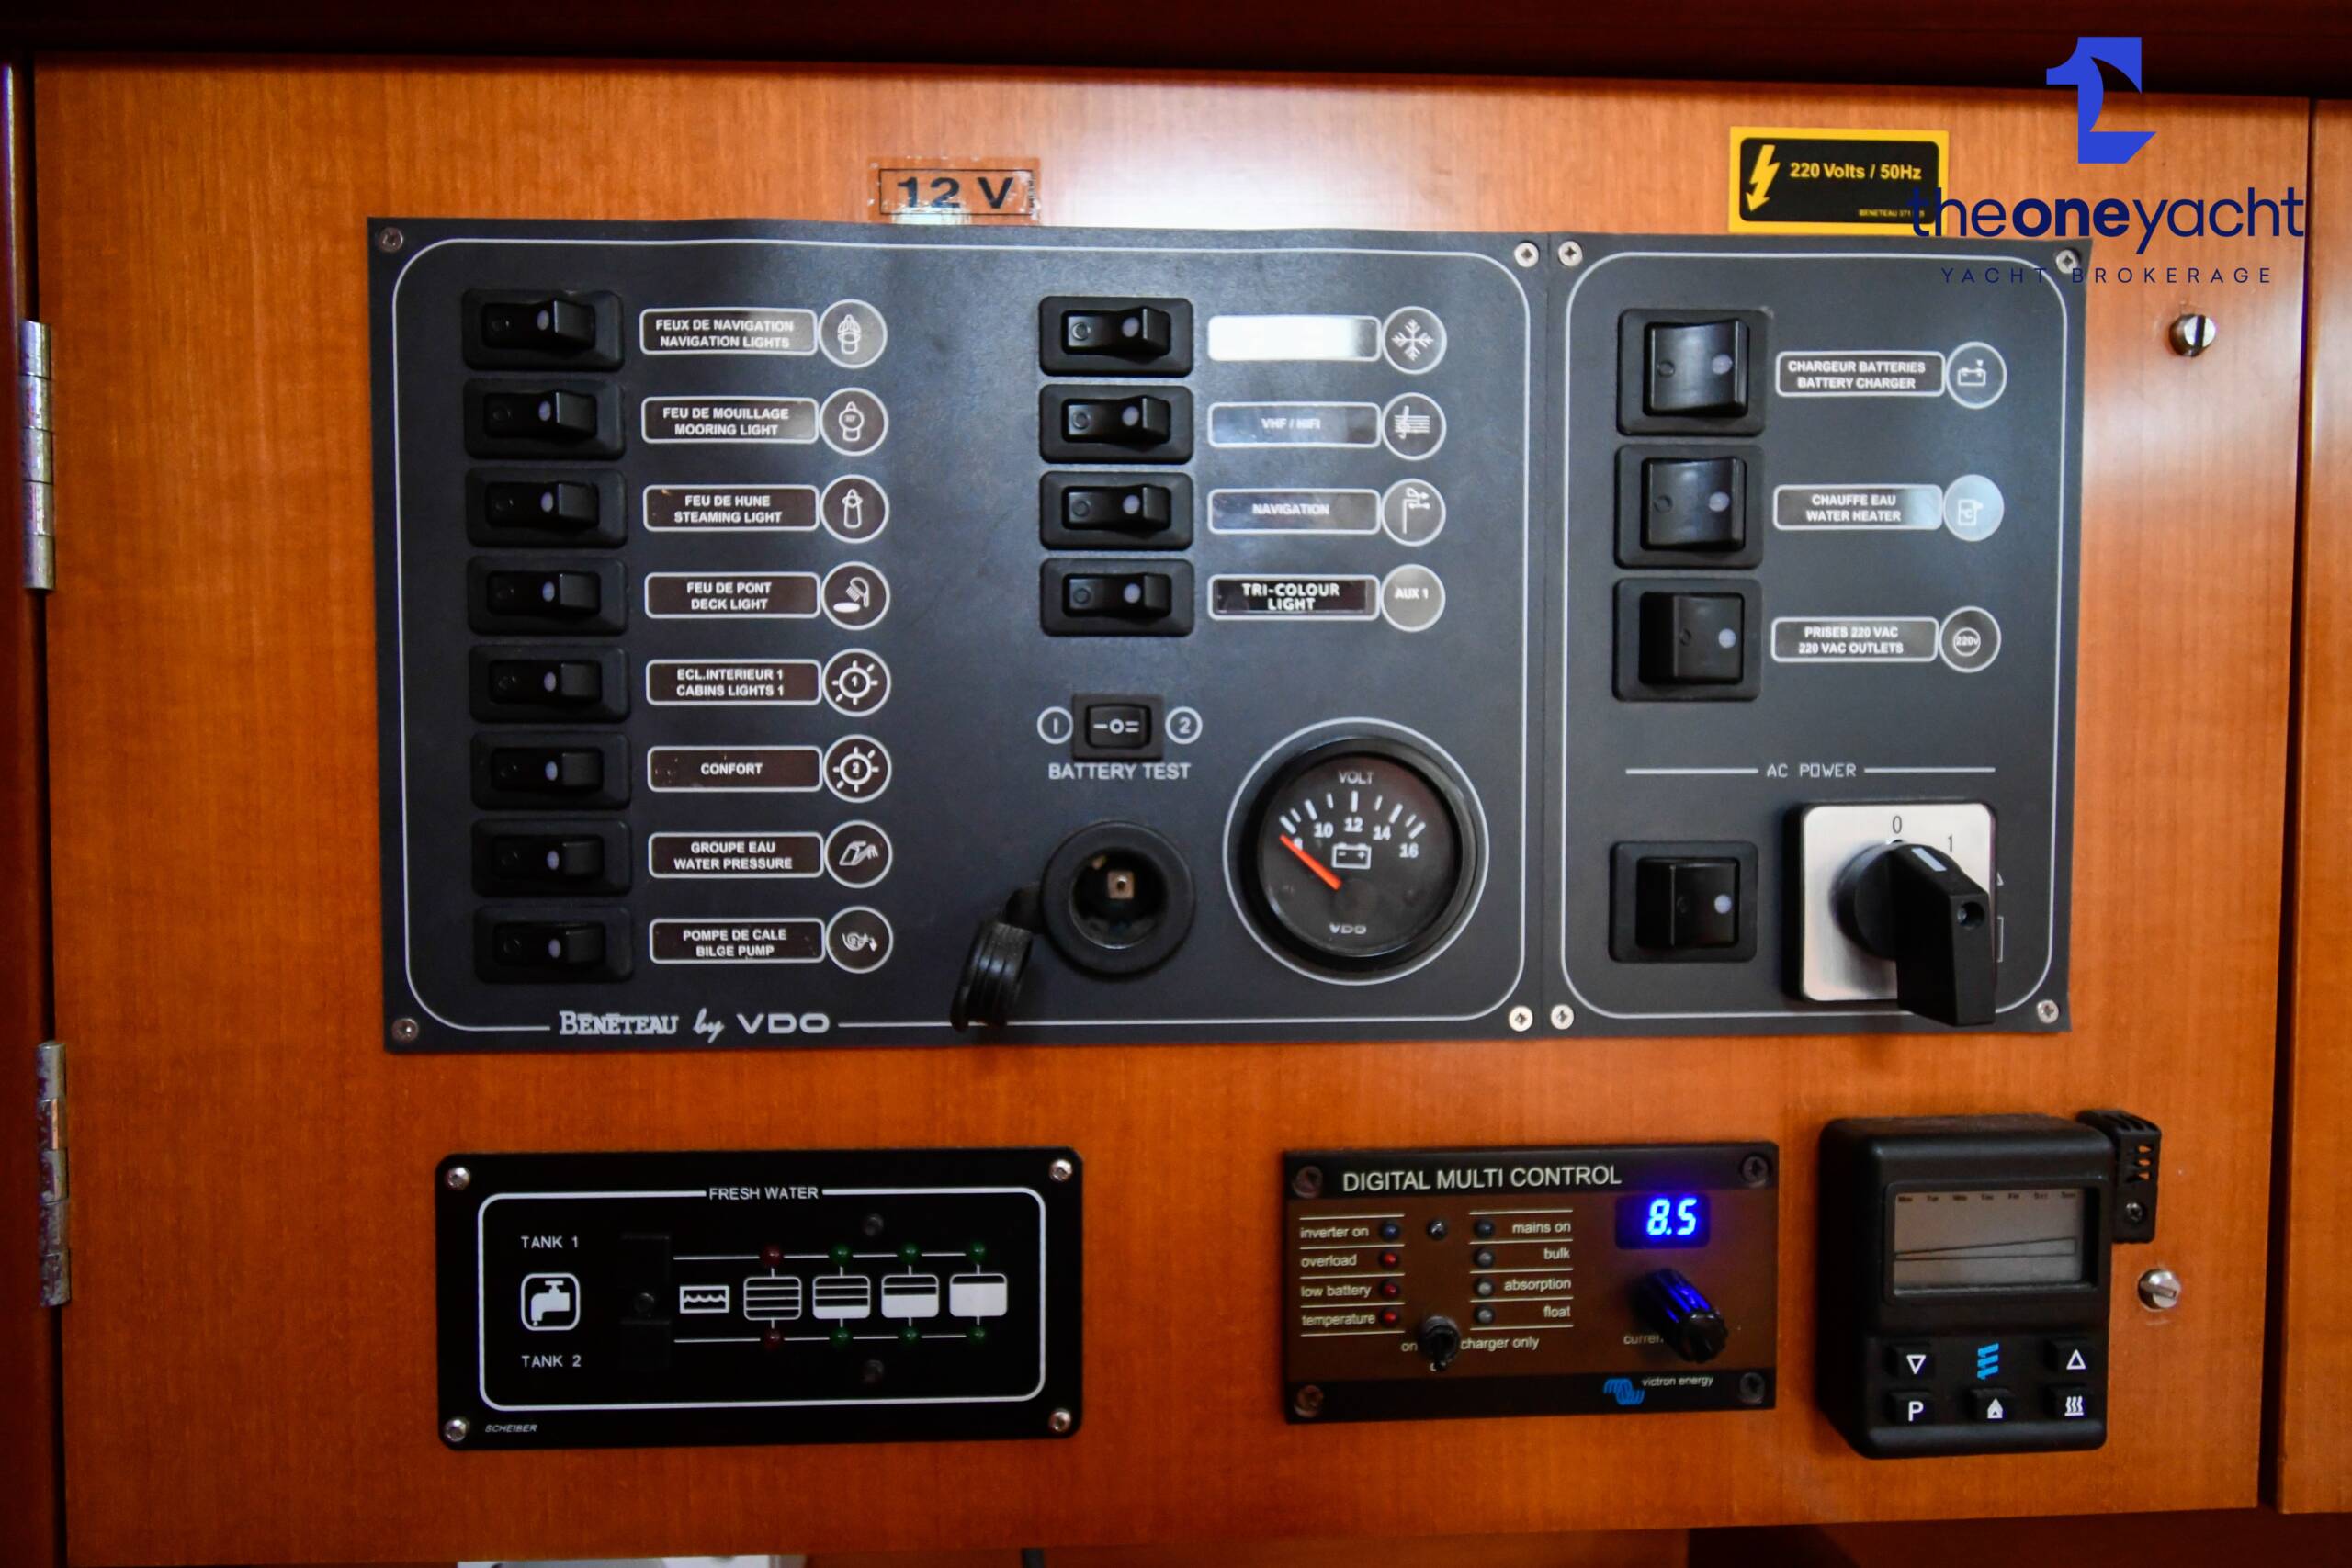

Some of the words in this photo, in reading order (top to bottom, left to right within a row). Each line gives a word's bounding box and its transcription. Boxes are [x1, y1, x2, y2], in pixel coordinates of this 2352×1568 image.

[1790, 162, 1821, 178] 220
[1824, 162, 1866, 179] Volts
[1869, 163, 1876, 180] /
[1880, 163, 1922, 181] 50Hz
[897, 176, 961, 209] 12
[977, 176, 1014, 209] V
[655, 319, 690, 332] FEUX
[694, 319, 710, 332] DE
[713, 319, 795, 333] NAVIGATION
[660, 335, 740, 348] NAVIGATION
[742, 336, 790, 349] LIGHTS
[1788, 360, 1857, 373] CHARGEUR
[1859, 360, 1926, 374] BATTERIES
[1797, 377, 1854, 389] BATTERY
[1856, 377, 1916, 389] CHARGER
[662, 407, 688, 420] FEU
[692, 407, 709, 420] DE
[713, 407, 789, 421] MOUILLAGE
[674, 423, 737, 436] MOORING
[740, 423, 778, 436] LIGHT
[1261, 418, 1287, 430] VHF
[684, 494, 710, 507] FEU
[713, 494, 731, 507] DE
[735, 494, 771, 507] HUNE
[1812, 493, 1869, 506] CHAUFFE
[1871, 493, 1896, 506] EAU
[1252, 503, 1330, 515] NAVIGATION
[674, 511, 741, 524] STEAMING
[744, 511, 782, 524] LIGHT
[1805, 510, 1850, 523] WATER
[1853, 510, 1902, 523] HEATER
[687, 581, 713, 594] FEU
[716, 581, 733, 594] DE
[736, 581, 772, 594] PONT
[1241, 582, 1340, 597] TRI-COLOUR
[1395, 587, 1419, 600] AUX
[1422, 588, 1429, 600] 1
[691, 598, 727, 611] DECK
[730, 598, 768, 611] LIGHT
[1267, 597, 1317, 611] LIGHT
[1804, 626, 1849, 638] PRISES
[1851, 626, 1871, 638] 220
[1872, 626, 1899, 638] VAC
[1799, 642, 1819, 654] 220
[1821, 642, 1847, 654] VAC
[1849, 642, 1904, 654] OUTLETS
[677, 669, 774, 682] ECL.INTERIEUR
[777, 669, 784, 681] 1
[851, 676, 859, 687] 1
[676, 684, 725, 697] CABINS
[728, 684, 774, 697] LIGHTS
[778, 684, 785, 696] 1
[1178, 717, 1192, 734] 2
[700, 762, 763, 776] CONFORT
[852, 762, 860, 774] 2
[1047, 762, 1136, 780] BATTERY
[1144, 762, 1192, 780] TEST
[1767, 763, 1788, 778] AC
[1800, 763, 1857, 778] POWER
[1338, 771, 1374, 784] VOLT
[1892, 815, 1903, 834] 0
[1314, 822, 1334, 838] 10
[1345, 817, 1363, 832] 12
[1373, 825, 1392, 841] 14
[1399, 842, 1419, 858] 16
[1947, 833, 1953, 853] 1
[690, 841, 745, 854] GROUPE
[748, 841, 775, 854] EAU
[673, 858, 719, 871] WATER
[723, 857, 793, 870] PRESSURE
[683, 929, 729, 942] POMPE
[731, 929, 749, 942] DE
[752, 929, 787, 942] CALE
[1329, 923, 1367, 935] VDO
[696, 945, 735, 957] BILGE
[738, 944, 775, 957] PUMP
[692, 1007, 725, 1044] by
[736, 1012, 831, 1035] VDO
[1342, 1170, 1431, 1192] DIGITAL
[1437, 1168, 1504, 1190] MULTI
[1510, 1165, 1623, 1188] CONTROL
[709, 1187, 761, 1201] FRESH
[764, 1186, 820, 1200] WATER
[1646, 1198, 1698, 1236] 8.5
[1300, 1227, 1349, 1239] inverter
[1352, 1227, 1369, 1237] on
[1512, 1222, 1552, 1235] mains
[1555, 1223, 1571, 1234] on
[520, 1235, 564, 1249] TANK
[571, 1235, 580, 1248] 1
[1544, 1247, 1570, 1260] bulk
[1301, 1254, 1358, 1268] overload
[1301, 1286, 1323, 1297] low
[1327, 1284, 1372, 1299] battery
[1504, 1278, 1572, 1292] absorption
[1544, 1305, 1571, 1318] float
[1302, 1314, 1376, 1328] temperature
[1460, 1337, 1510, 1352] charger
[1512, 1336, 1540, 1351] only
[1623, 1334, 1664, 1345] curre
[1400, 1341, 1418, 1352] on
[521, 1354, 564, 1368] TANK
[572, 1354, 582, 1368] 2
[1642, 1377, 1677, 1387] victron
[1679, 1375, 1714, 1388] energy
[1908, 1400, 1925, 1422] P
[485, 1424, 538, 1433] SCHEIBER
